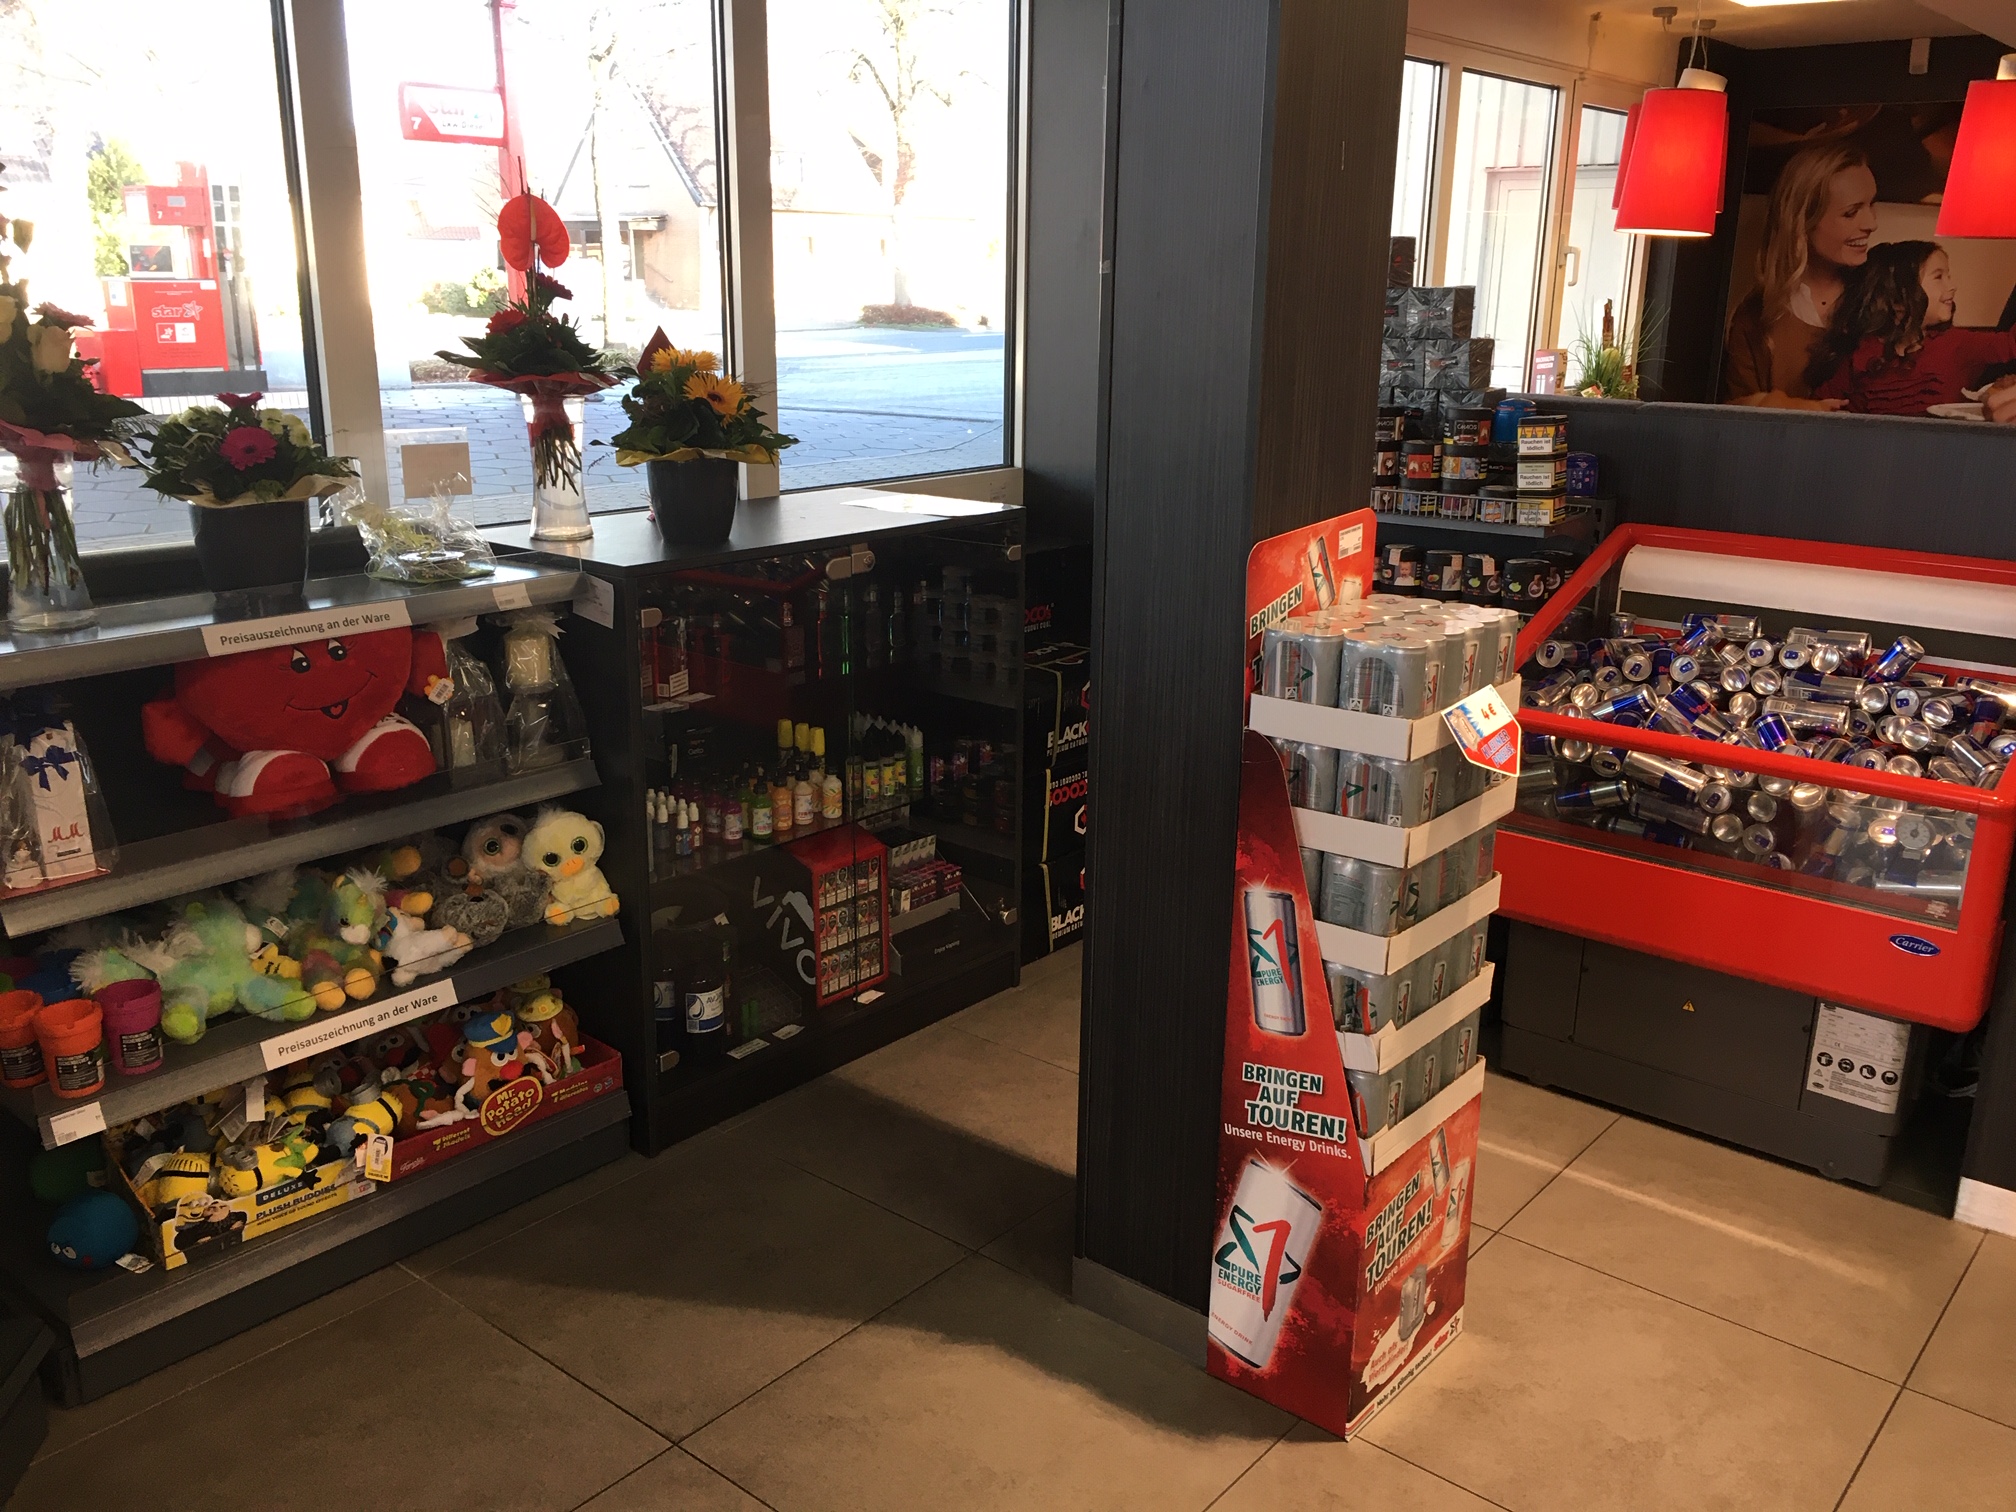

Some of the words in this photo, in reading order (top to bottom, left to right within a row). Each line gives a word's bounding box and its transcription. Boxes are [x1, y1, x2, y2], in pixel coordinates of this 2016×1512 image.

[411, 116, 422, 130] 7
[157, 210, 163, 219] 7
[152, 304, 183, 318] star
[1250, 582, 1303, 637] BRINGEN
[220, 621, 324, 646] Preisauszeichnung
[326, 619, 341, 629] an
[342, 616, 361, 628] der
[362, 611, 391, 624] Ware
[1481, 702, 1497, 720] 4€
[1480, 728, 1511, 760] KLEINER
[1895, 936, 1934, 953] Carrier
[1256, 975, 1284, 987] ENERGY
[1261, 967, 1282, 979] PURE
[278, 1016, 376, 1057] Preisauszeichnung
[377, 1012, 391, 1023] an
[392, 1006, 409, 1018] der
[410, 994, 438, 1010] Ware
[1243, 1063, 1322, 1093] BRINGEN
[486, 1087, 535, 1122] Potato
[496, 1088, 516, 1105] Mr.
[1258, 1085, 1298, 1107] AUF
[495, 1098, 532, 1129] Head
[1246, 1102, 1346, 1142] TOUREN!
[1224, 1123, 1263, 1141] Unsere
[1266, 1131, 1306, 1152] Energy
[1309, 1143, 1352, 1160] Drinks.
[256, 1200, 292, 1220] PLUSH
[293, 1183, 337, 1205] BUDDIES
[262, 1181, 303, 1201] DELUXE
[1367, 1172, 1420, 1245] BRINGEN
[1366, 1197, 1433, 1291] TOUREN!
[1376, 1211, 1404, 1256] AUF
[1375, 1265, 1399, 1295] Unsere
[1399, 1240, 1422, 1267] Energy
[1422, 1213, 1445, 1241] Drinks.
[1218, 1268, 1262, 1296] ENERGY
[1230, 1262, 1262, 1286] PURE
[1217, 1278, 1262, 1304] SUGARFREE
[1211, 1311, 1234, 1331] ENERGY
[1233, 1328, 1253, 1346] DRINK
